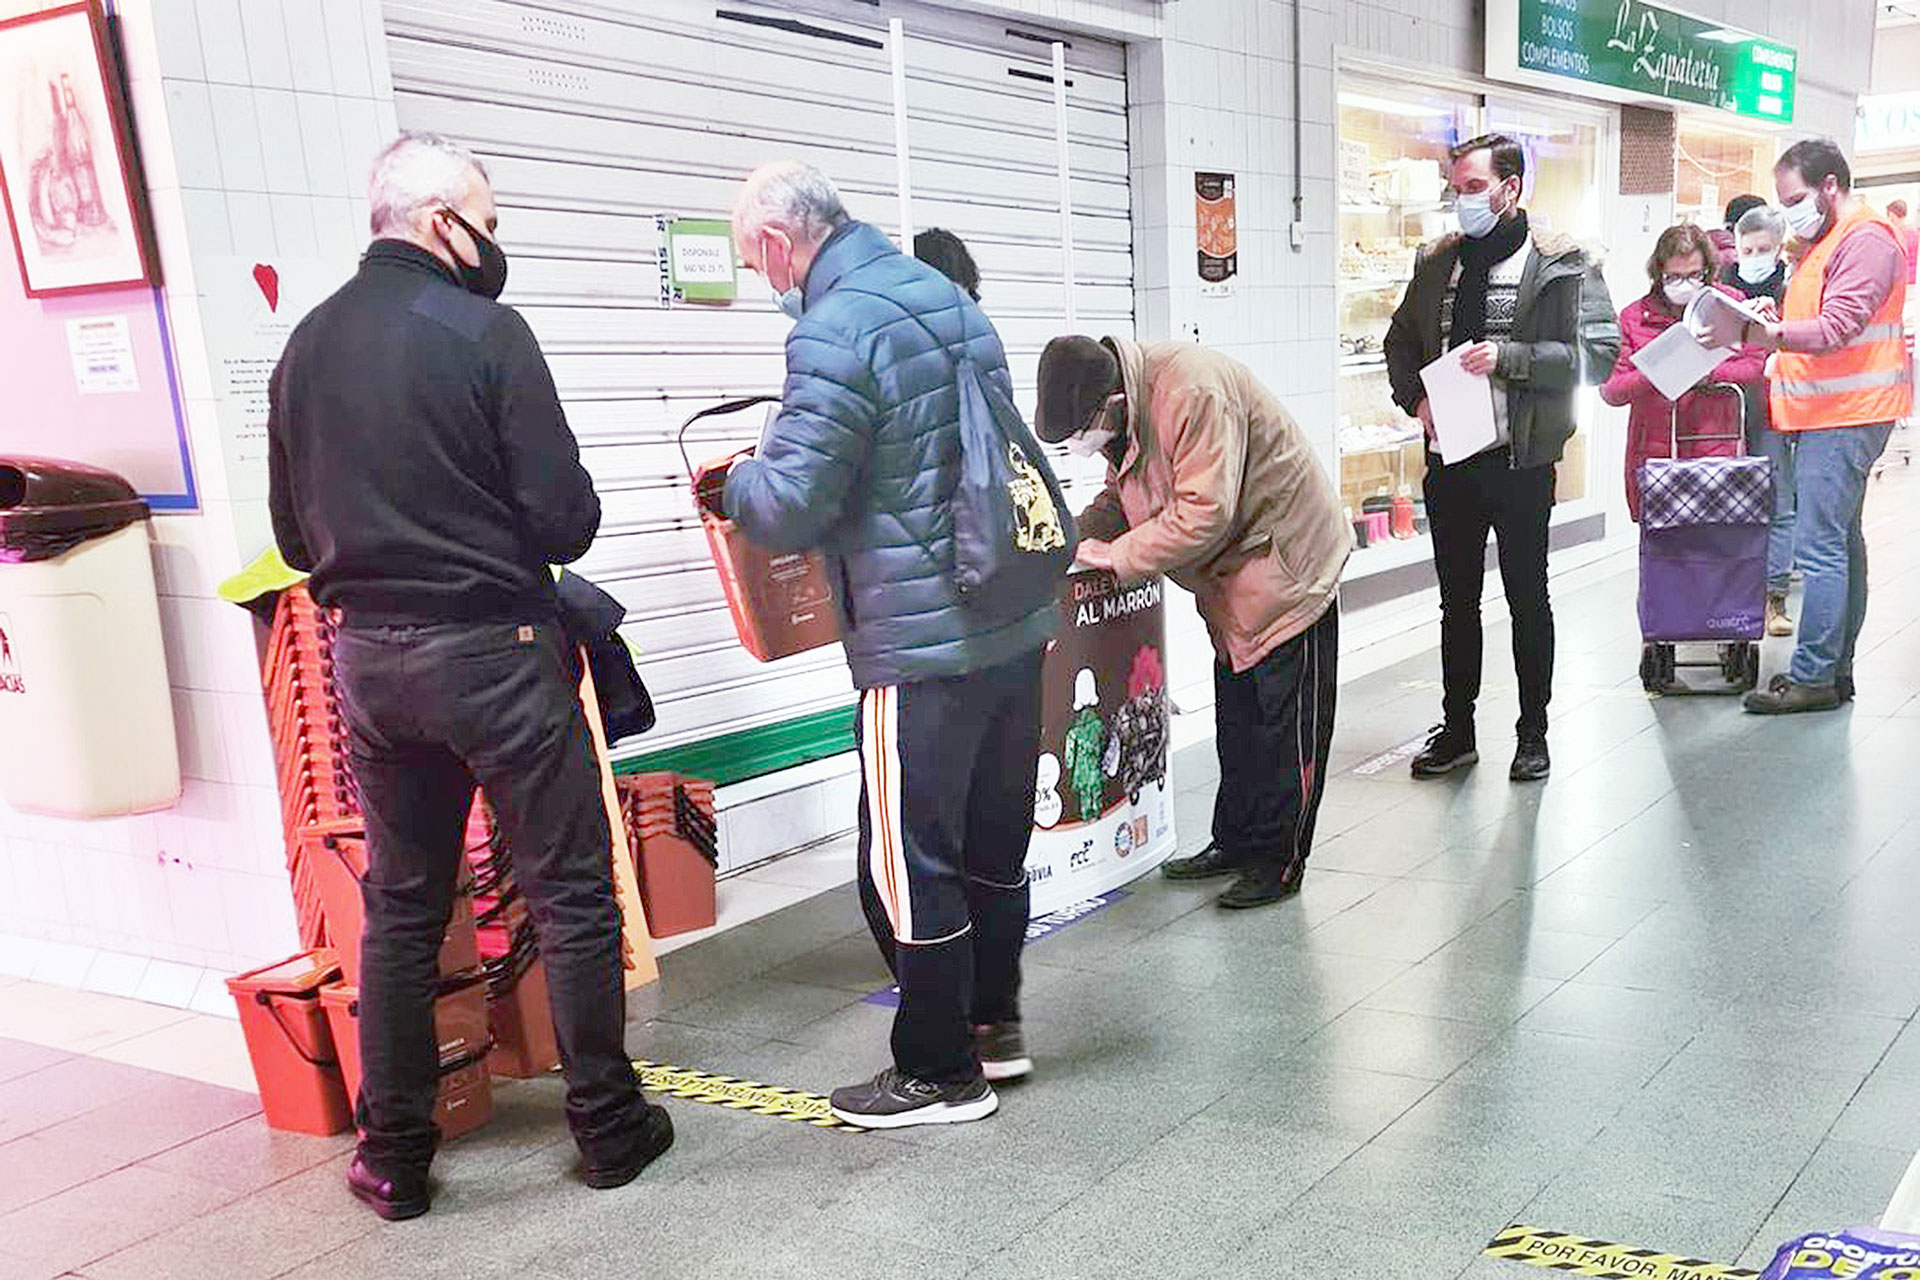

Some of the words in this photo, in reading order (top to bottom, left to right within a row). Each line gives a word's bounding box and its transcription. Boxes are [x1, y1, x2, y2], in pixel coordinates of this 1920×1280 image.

[1541, 14, 1574, 41] BOLSOS
[1522, 41, 1590, 74] COMPLEMENTOS
[1076, 602, 1100, 627] AL
[1103, 580, 1161, 620] MARRÓN
[1027, 865, 1053, 883] OVIA
[1526, 1240, 1576, 1259] POR
[1578, 1250, 1659, 1278] FAVOR,
[1792, 1249, 1866, 1279] DE
[1803, 1237, 1920, 1266] OPORTU
